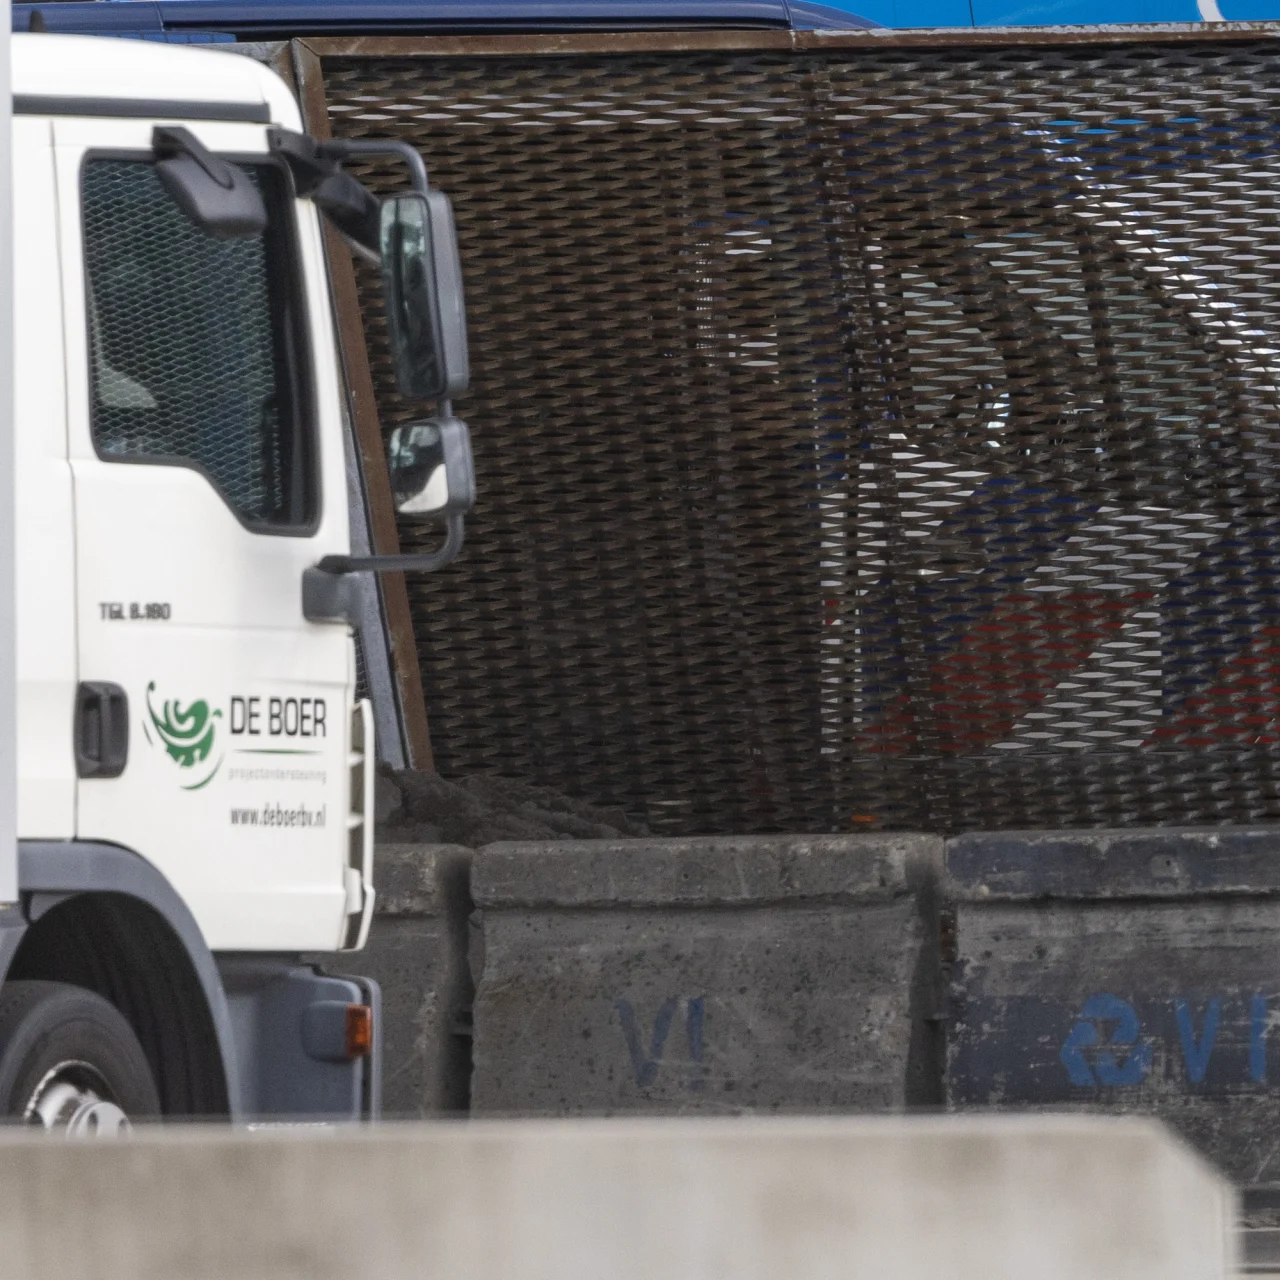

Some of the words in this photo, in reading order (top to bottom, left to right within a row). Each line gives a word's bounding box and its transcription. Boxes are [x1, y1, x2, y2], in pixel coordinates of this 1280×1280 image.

[230, 696, 261, 735] DE
[269, 696, 327, 737] BOER
[230, 801, 326, 828] www.deboerbv.nl
